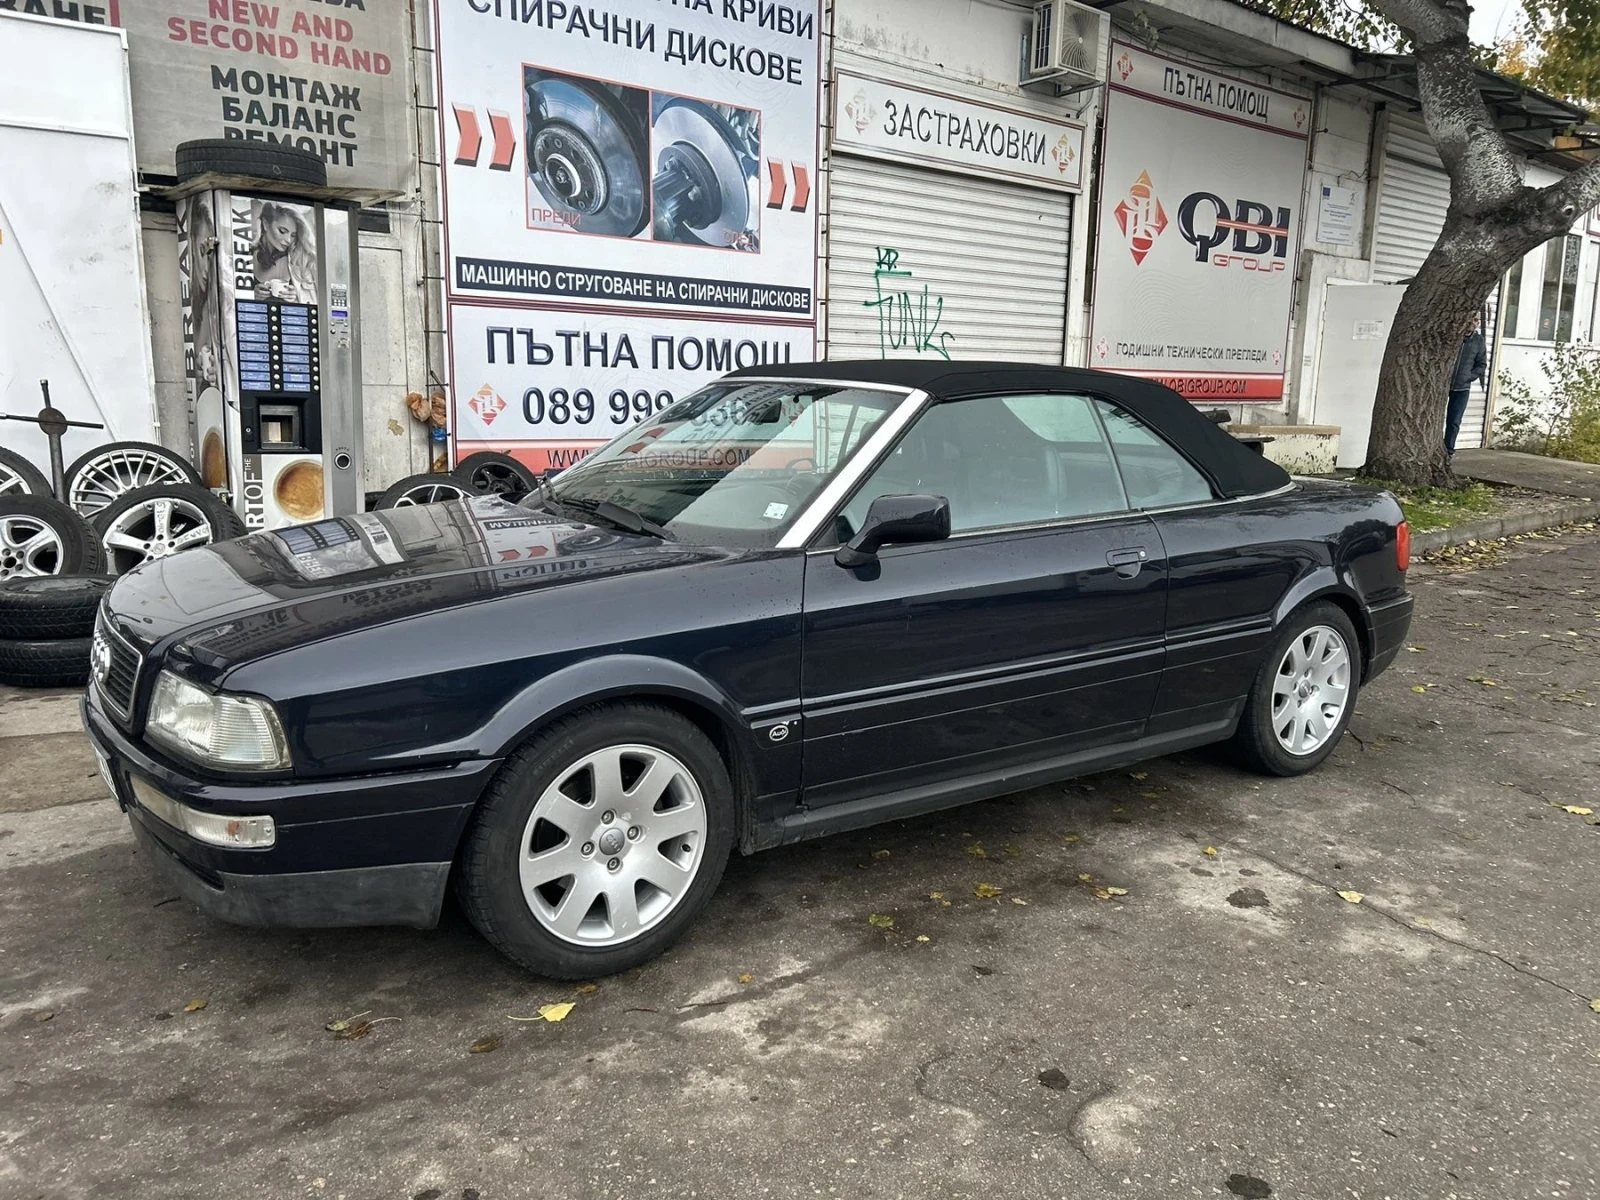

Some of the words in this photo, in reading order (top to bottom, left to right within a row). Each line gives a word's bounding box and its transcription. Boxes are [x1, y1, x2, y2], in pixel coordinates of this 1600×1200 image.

[208, 0, 280, 29] NEW
[291, 11, 354, 43] AND
[722, 0, 813, 40] КРИВИ
[167, 16, 299, 60] SECOND
[310, 41, 391, 75] HAND
[664, 28, 803, 86] ДИСКОВЕ
[210, 64, 362, 111] МОНТАЖ
[1163, 66, 1214, 105] ПЪТНА
[1217, 82, 1270, 123] ПОМОЩ
[222, 96, 357, 138] БАЛАНС
[883, 99, 1047, 166] ЗАСТРАХОВКИ
[531, 207, 582, 227] ПРЕДИ
[722, 228, 755, 248] СЛЕД
[232, 208, 254, 291] BREAK
[461, 263, 552, 289] МАШИННО
[555, 271, 653, 297] СТРУГОВАНЕ
[656, 280, 676, 299] НА
[678, 282, 749, 304] СПИРАЧНИ
[751, 288, 809, 309] ДИСКОВЕ
[486, 325, 639, 369] ПЪТНА
[1116, 342, 1164, 358] ГОДИШНИ
[1166, 345, 1224, 360] ТЕХНИЧЕСКИ
[1225, 348, 1267, 363] ПРЕГЛЕДИ
[522, 386, 595, 425] 089
[608, 388, 674, 425] 999
[244, 458, 252, 471] THE
